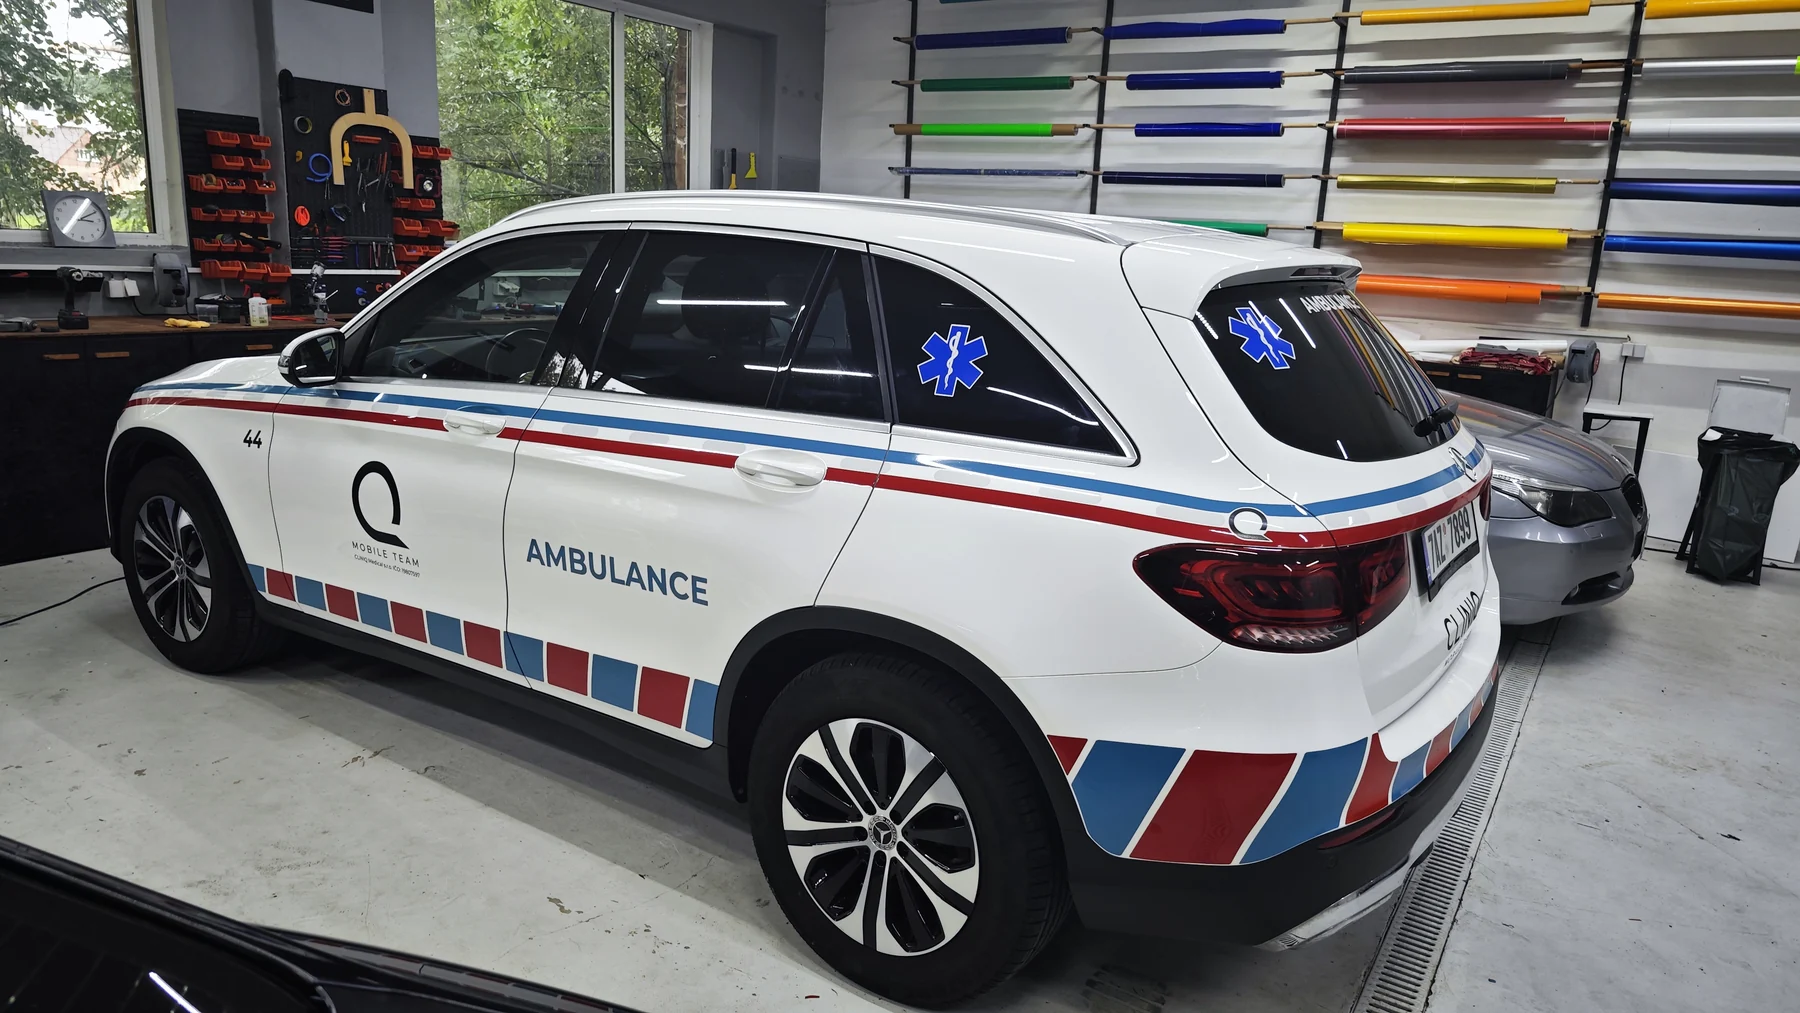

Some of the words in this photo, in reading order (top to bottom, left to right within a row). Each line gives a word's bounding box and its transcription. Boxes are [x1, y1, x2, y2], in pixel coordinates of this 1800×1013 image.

[243, 429, 262, 449] 44
[351, 461, 409, 549] Q
[352, 541, 388, 559] MOBILE
[392, 552, 420, 567] TEAM
[526, 538, 709, 607] AMBULANCE
[1428, 525, 1446, 573] 7AZ
[1447, 506, 1471, 554] 7899
